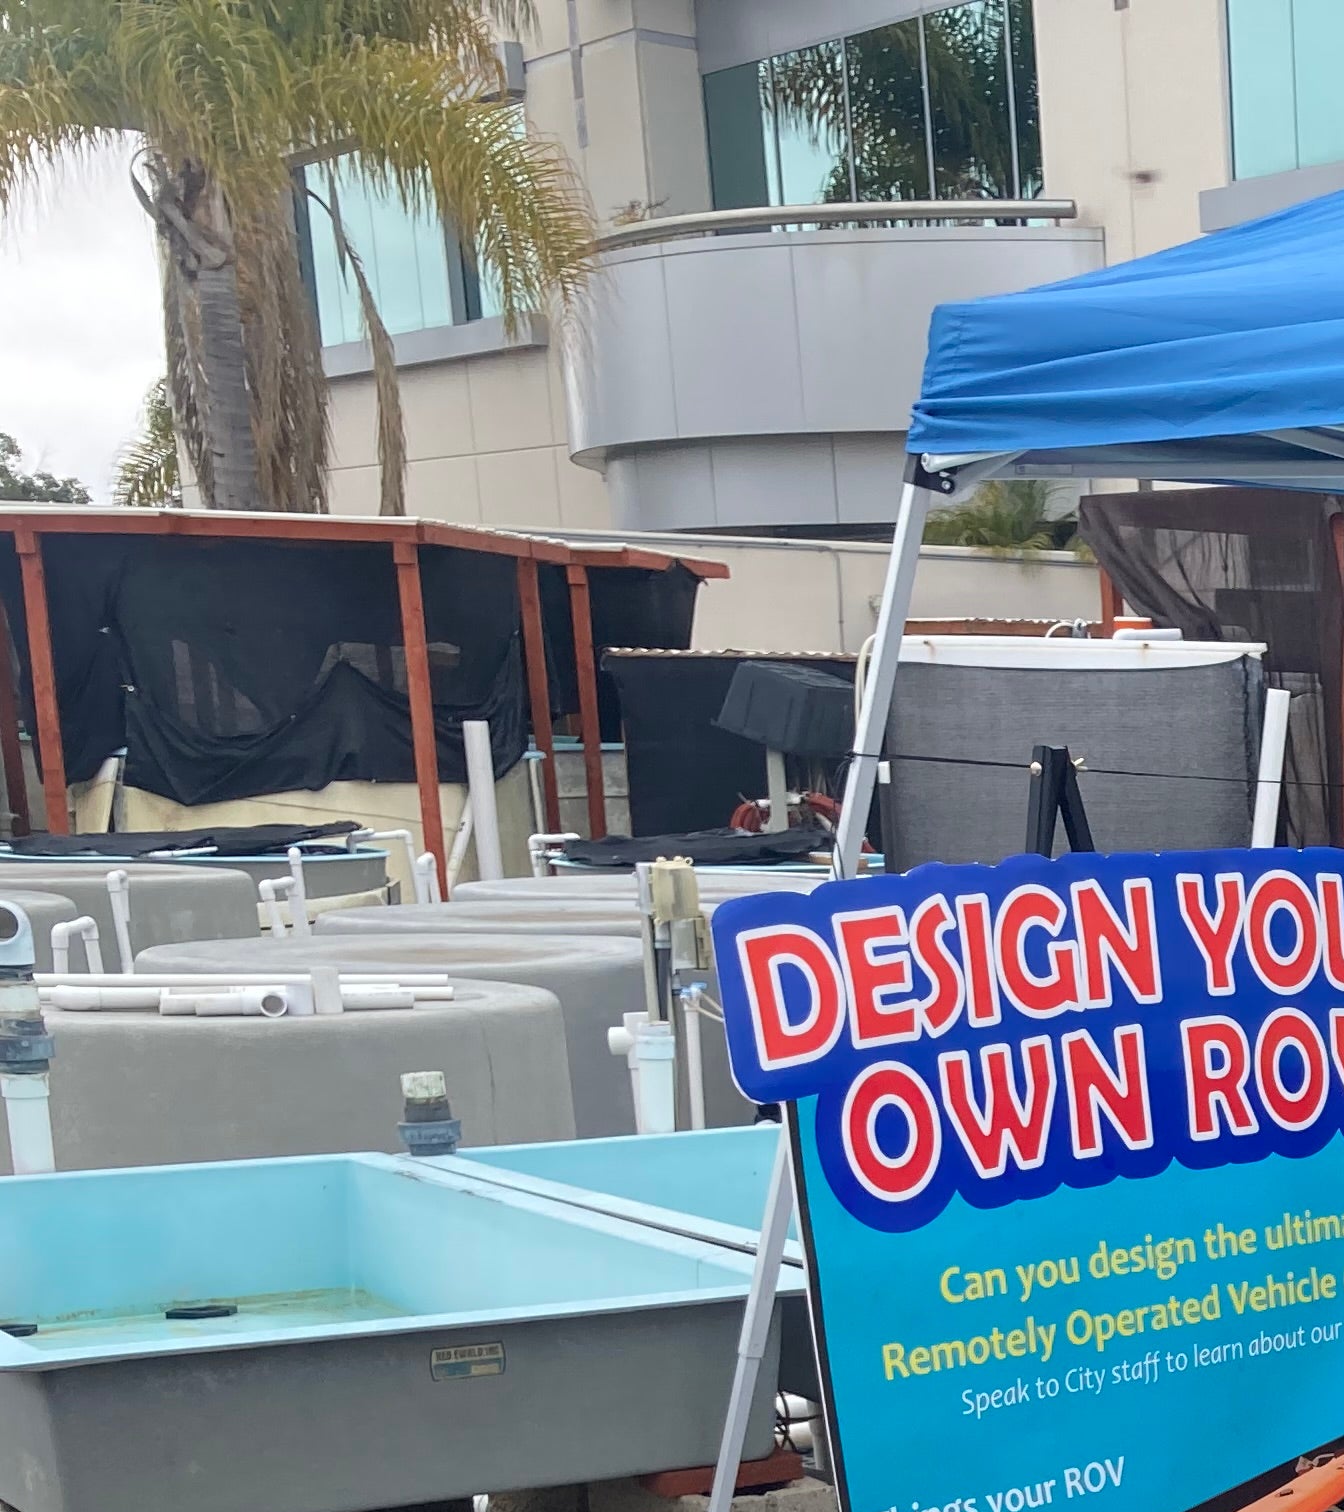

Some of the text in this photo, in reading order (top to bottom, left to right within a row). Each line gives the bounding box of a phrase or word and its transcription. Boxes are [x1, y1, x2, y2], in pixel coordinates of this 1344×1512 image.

[735, 877, 1163, 1071] DESIGN
[841, 1023, 1154, 1203] OWN
[940, 1266, 1008, 1303] Can
[1016, 1256, 1080, 1302] you
[1089, 1233, 1197, 1280] design
[1204, 1223, 1258, 1260] the
[882, 1316, 1056, 1381] Remotely
[1066, 1283, 1221, 1352] Operated
[1227, 1267, 1337, 1314] Vehicle
[962, 1377, 1030, 1420] Speak
[1036, 1376, 1060, 1399] to
[1065, 1366, 1106, 1394] City
[1111, 1350, 1161, 1384] staff
[1166, 1354, 1188, 1373] to
[1194, 1343, 1244, 1367] learn
[1248, 1326, 1306, 1357] about
[1310, 1320, 1342, 1344] our
[1063, 1455, 1125, 1499] ROV
